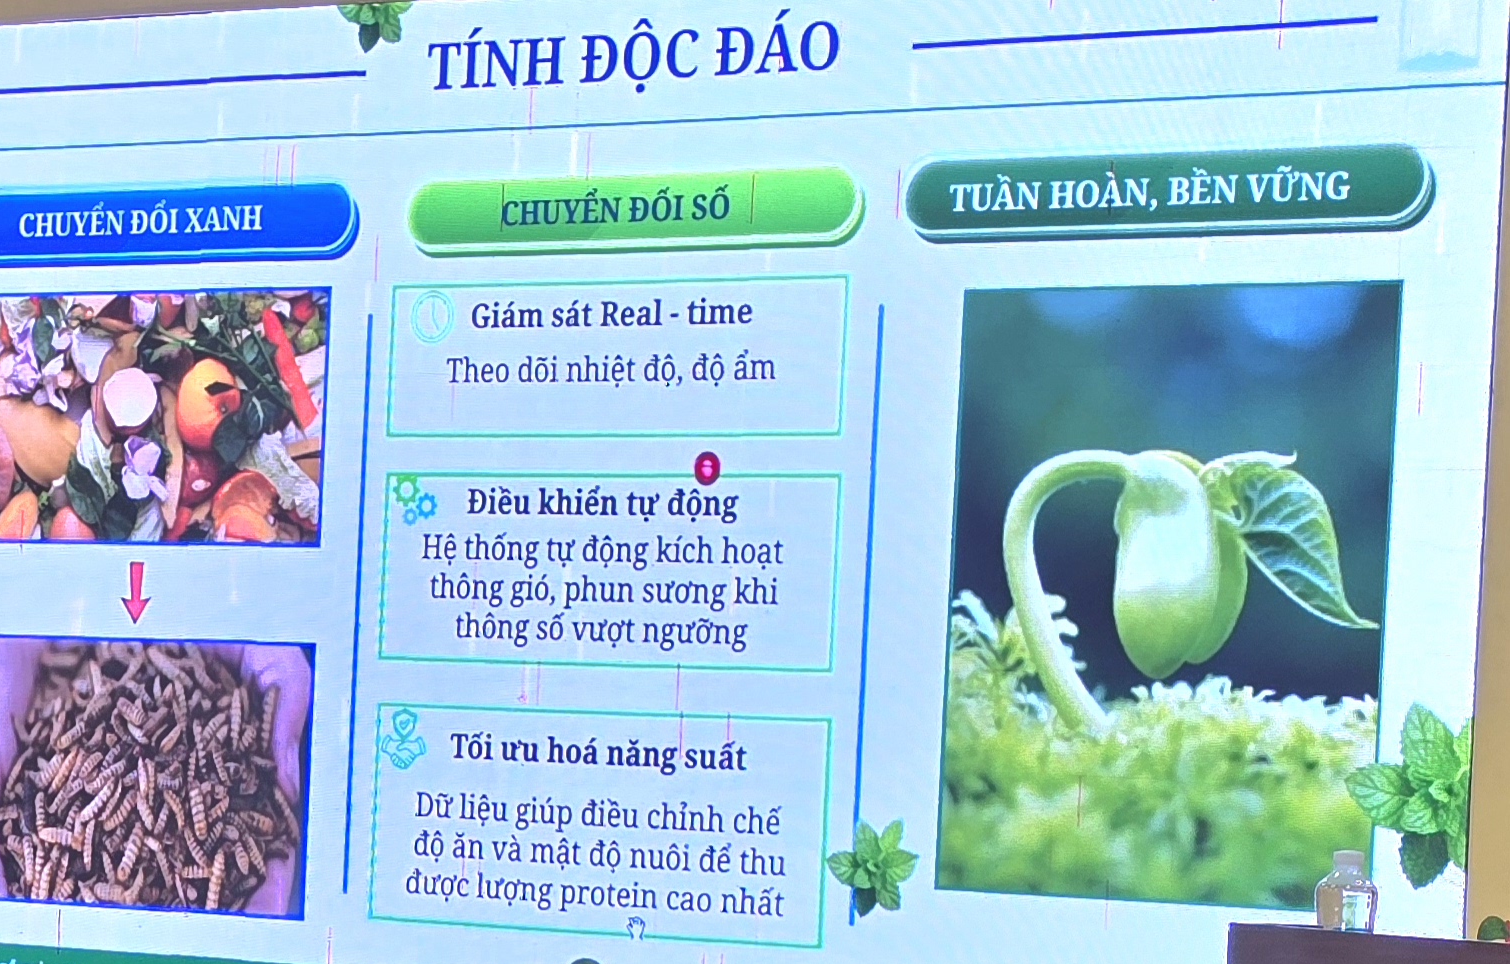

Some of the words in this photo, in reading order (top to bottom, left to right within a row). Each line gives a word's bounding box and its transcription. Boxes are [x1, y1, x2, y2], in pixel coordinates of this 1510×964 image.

[428, 27, 565, 90] TÍNH
[580, 17, 699, 93] ĐỘC
[714, 8, 839, 77] ĐÁO
[502, 187, 621, 226] CHUYỂN
[691, 184, 730, 220] SỐ
[949, 173, 1041, 213] TUẦN
[1047, 172, 1160, 211] HOÀN,
[1167, 168, 1244, 207] BỀN
[1249, 164, 1350, 203] VỮNG
[19, 201, 124, 238] CHUYỂN
[130, 199, 178, 234] ĐỔI
[185, 205, 263, 233] XANH
[471, 301, 543, 329] Giám
[551, 300, 592, 328] sát
[600, 300, 662, 326] Real
[687, 298, 753, 326] time
[447, 357, 509, 383] Theo
[518, 356, 558, 383] dõi
[565, 355, 635, 388] nhiệt
[643, 354, 684, 387] độ,
[691, 353, 725, 387] độ
[733, 349, 776, 380] ẩm
[467, 485, 530, 515] Điều
[538, 484, 618, 516] khiển
[627, 490, 660, 522] tự
[667, 488, 739, 524] động
[422, 533, 457, 566] Hệ
[465, 532, 539, 569] thống
[547, 538, 575, 566] tự
[582, 535, 649, 570] động
[656, 535, 714, 564] kích
[721, 536, 784, 570] hoạt
[430, 573, 505, 607] thông
[511, 574, 555, 607] gió,
[563, 575, 634, 609] phun
[642, 580, 727, 611] sương
[734, 577, 778, 606] khi
[456, 613, 530, 647] thông
[536, 612, 565, 641] số
[572, 619, 636, 648] vượt
[642, 618, 748, 652] ngưỡng
[450, 731, 493, 761] Tối
[500, 739, 538, 763] ưu
[546, 736, 598, 766] hoá
[605, 742, 678, 775] năng
[684, 742, 748, 772] suất
[414, 791, 453, 820] Dữ
[459, 793, 508, 826] liệu
[515, 797, 573, 832] giúp
[580, 799, 639, 829] điều
[647, 802, 724, 834] chỉnh
[732, 806, 782, 837] chế
[413, 830, 444, 860] độ
[452, 833, 485, 860] ăn
[492, 835, 521, 862] và
[529, 837, 582, 870] mật
[588, 839, 621, 872] độ
[629, 842, 691, 872] nuôi
[698, 843, 731, 875] để
[739, 847, 786, 877] thu
[405, 867, 471, 899] được
[477, 873, 552, 911] lượng
[560, 881, 657, 913] protein
[665, 891, 712, 914] cao
[719, 887, 785, 918] nhất
